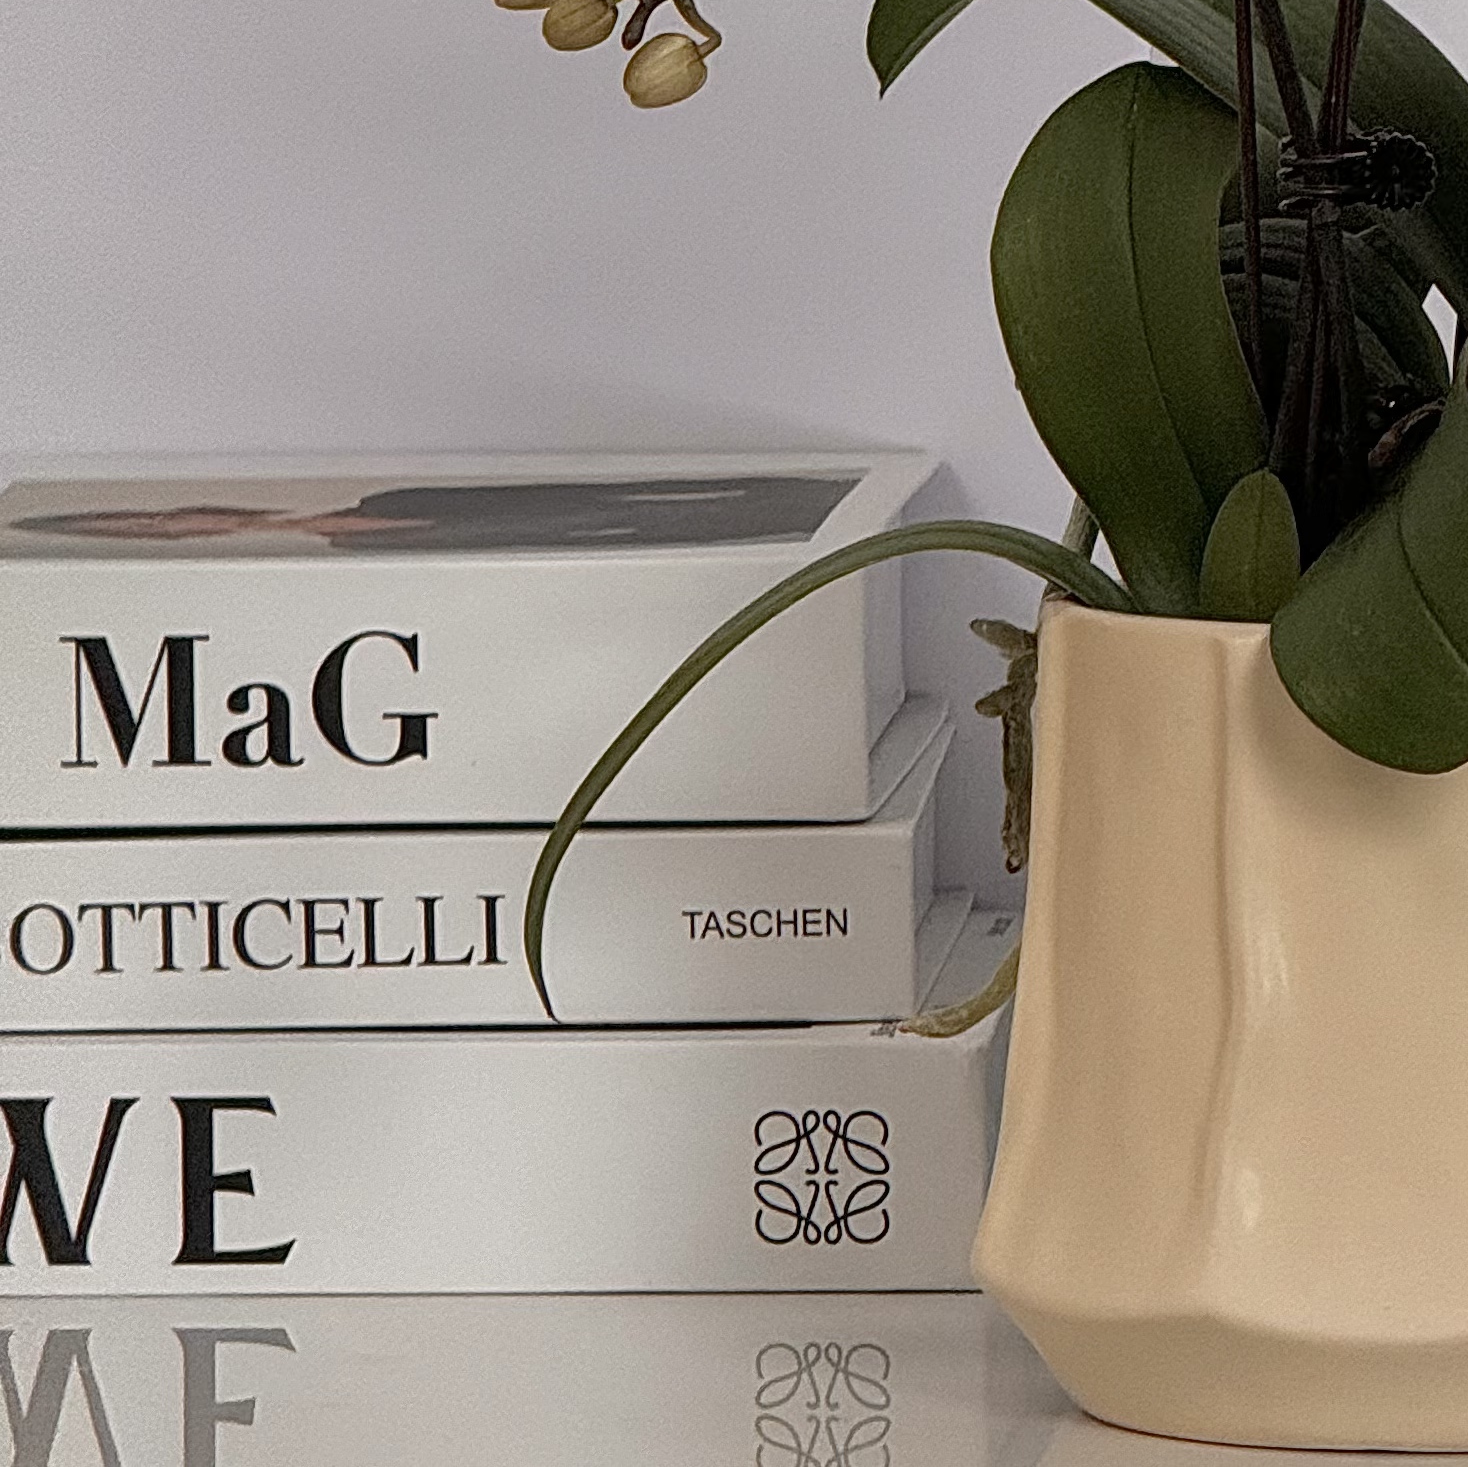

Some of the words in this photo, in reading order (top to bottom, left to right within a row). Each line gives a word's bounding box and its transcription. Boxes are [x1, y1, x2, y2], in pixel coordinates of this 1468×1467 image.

[60, 630, 439, 768] MaG
[0, 894, 507, 976] OTTICELLI
[682, 907, 849, 940] TASCHEN
